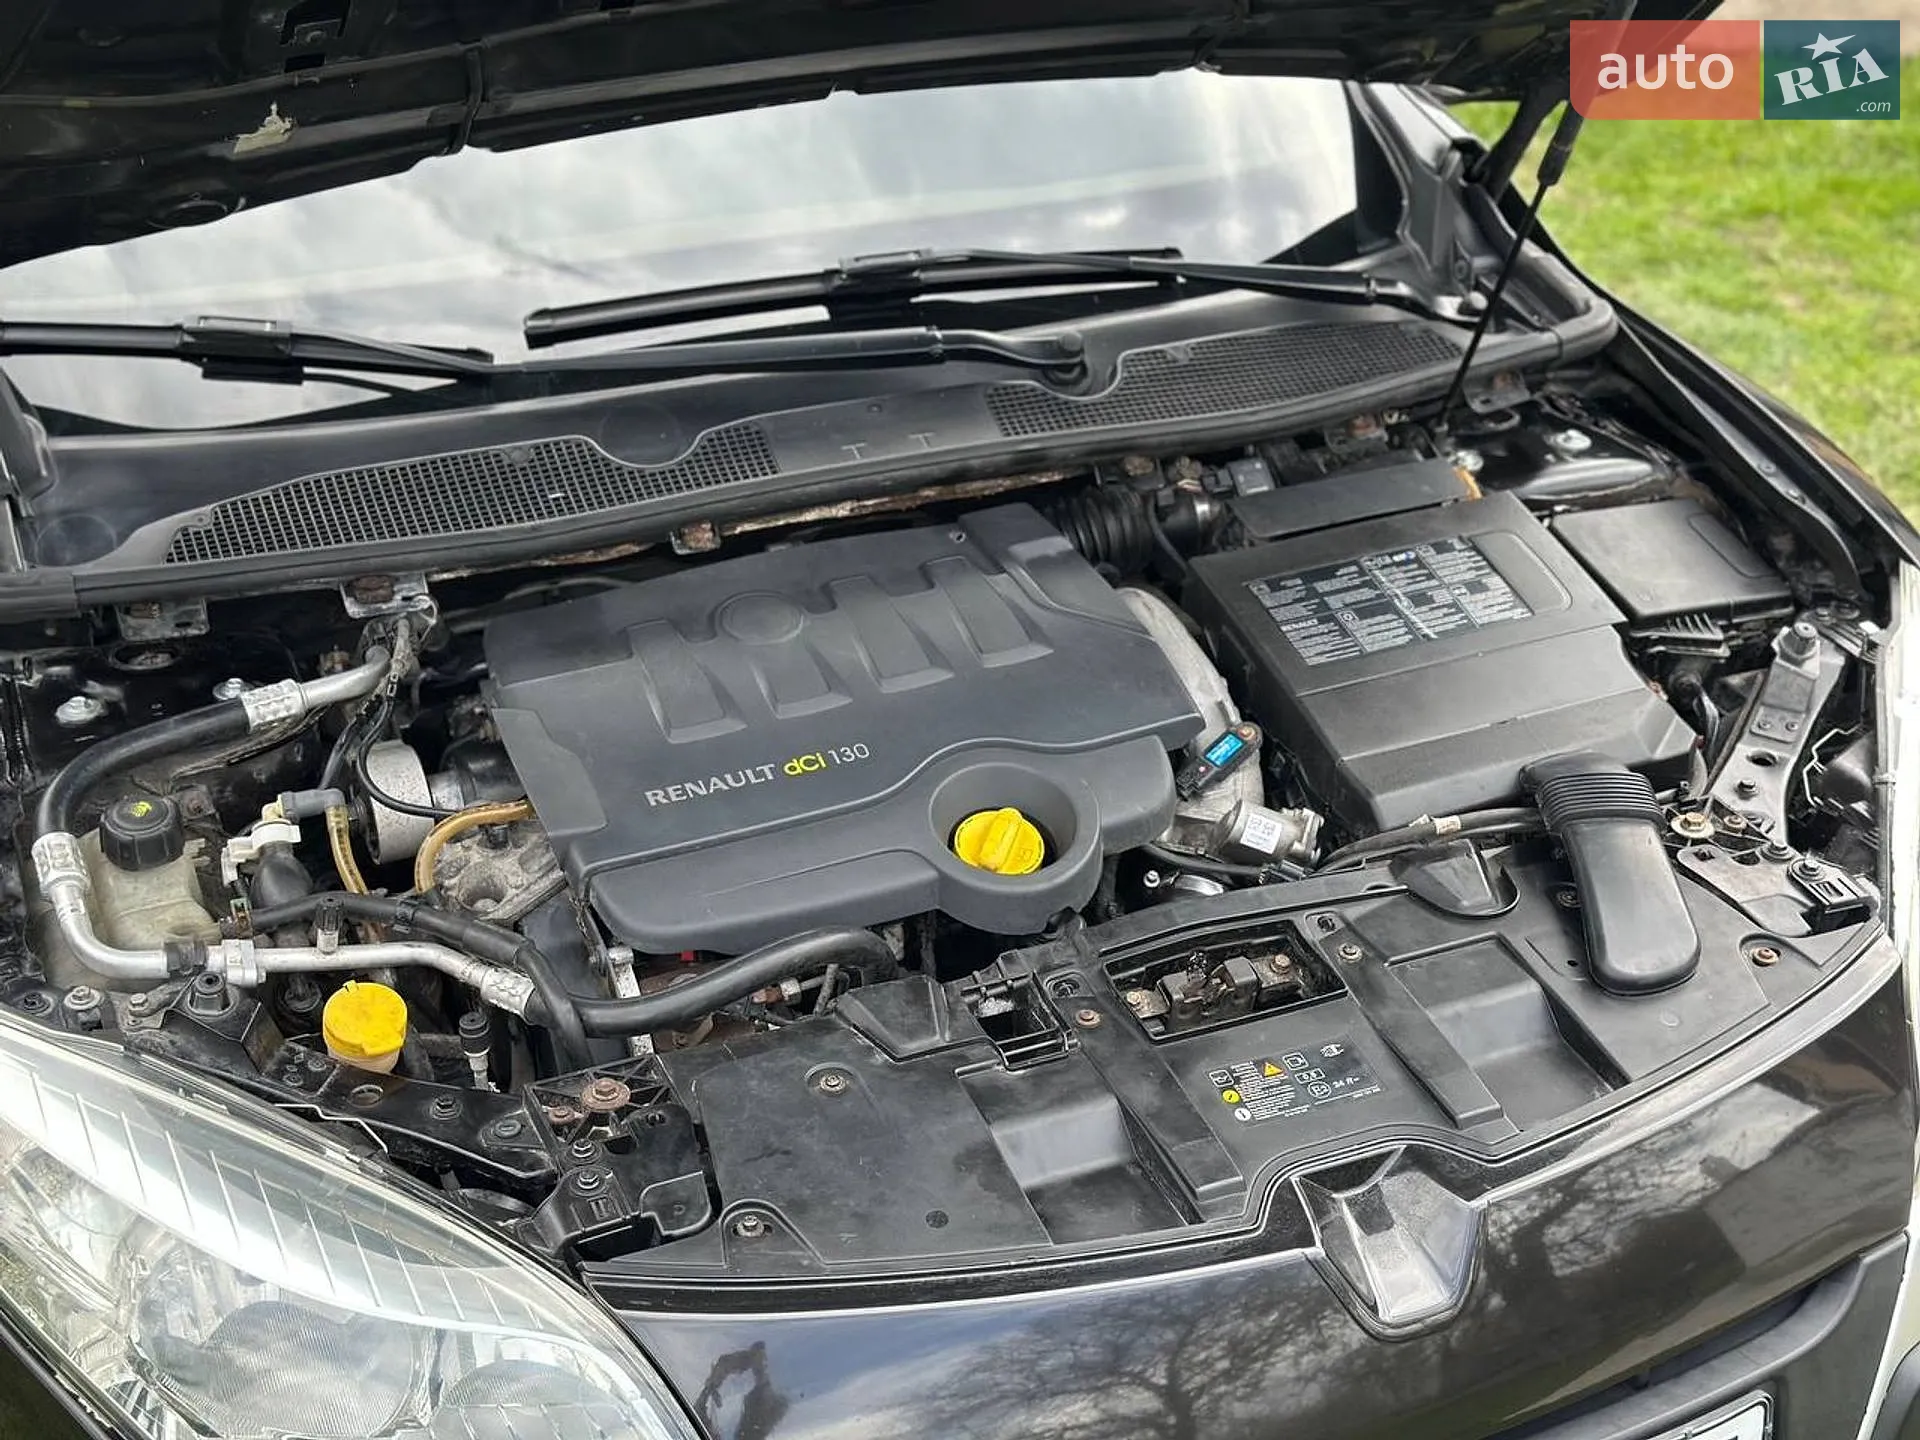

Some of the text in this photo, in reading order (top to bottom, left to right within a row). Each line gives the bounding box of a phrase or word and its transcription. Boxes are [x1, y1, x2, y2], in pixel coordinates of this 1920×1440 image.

[645, 743, 870, 807] RENAULT dCi 130
